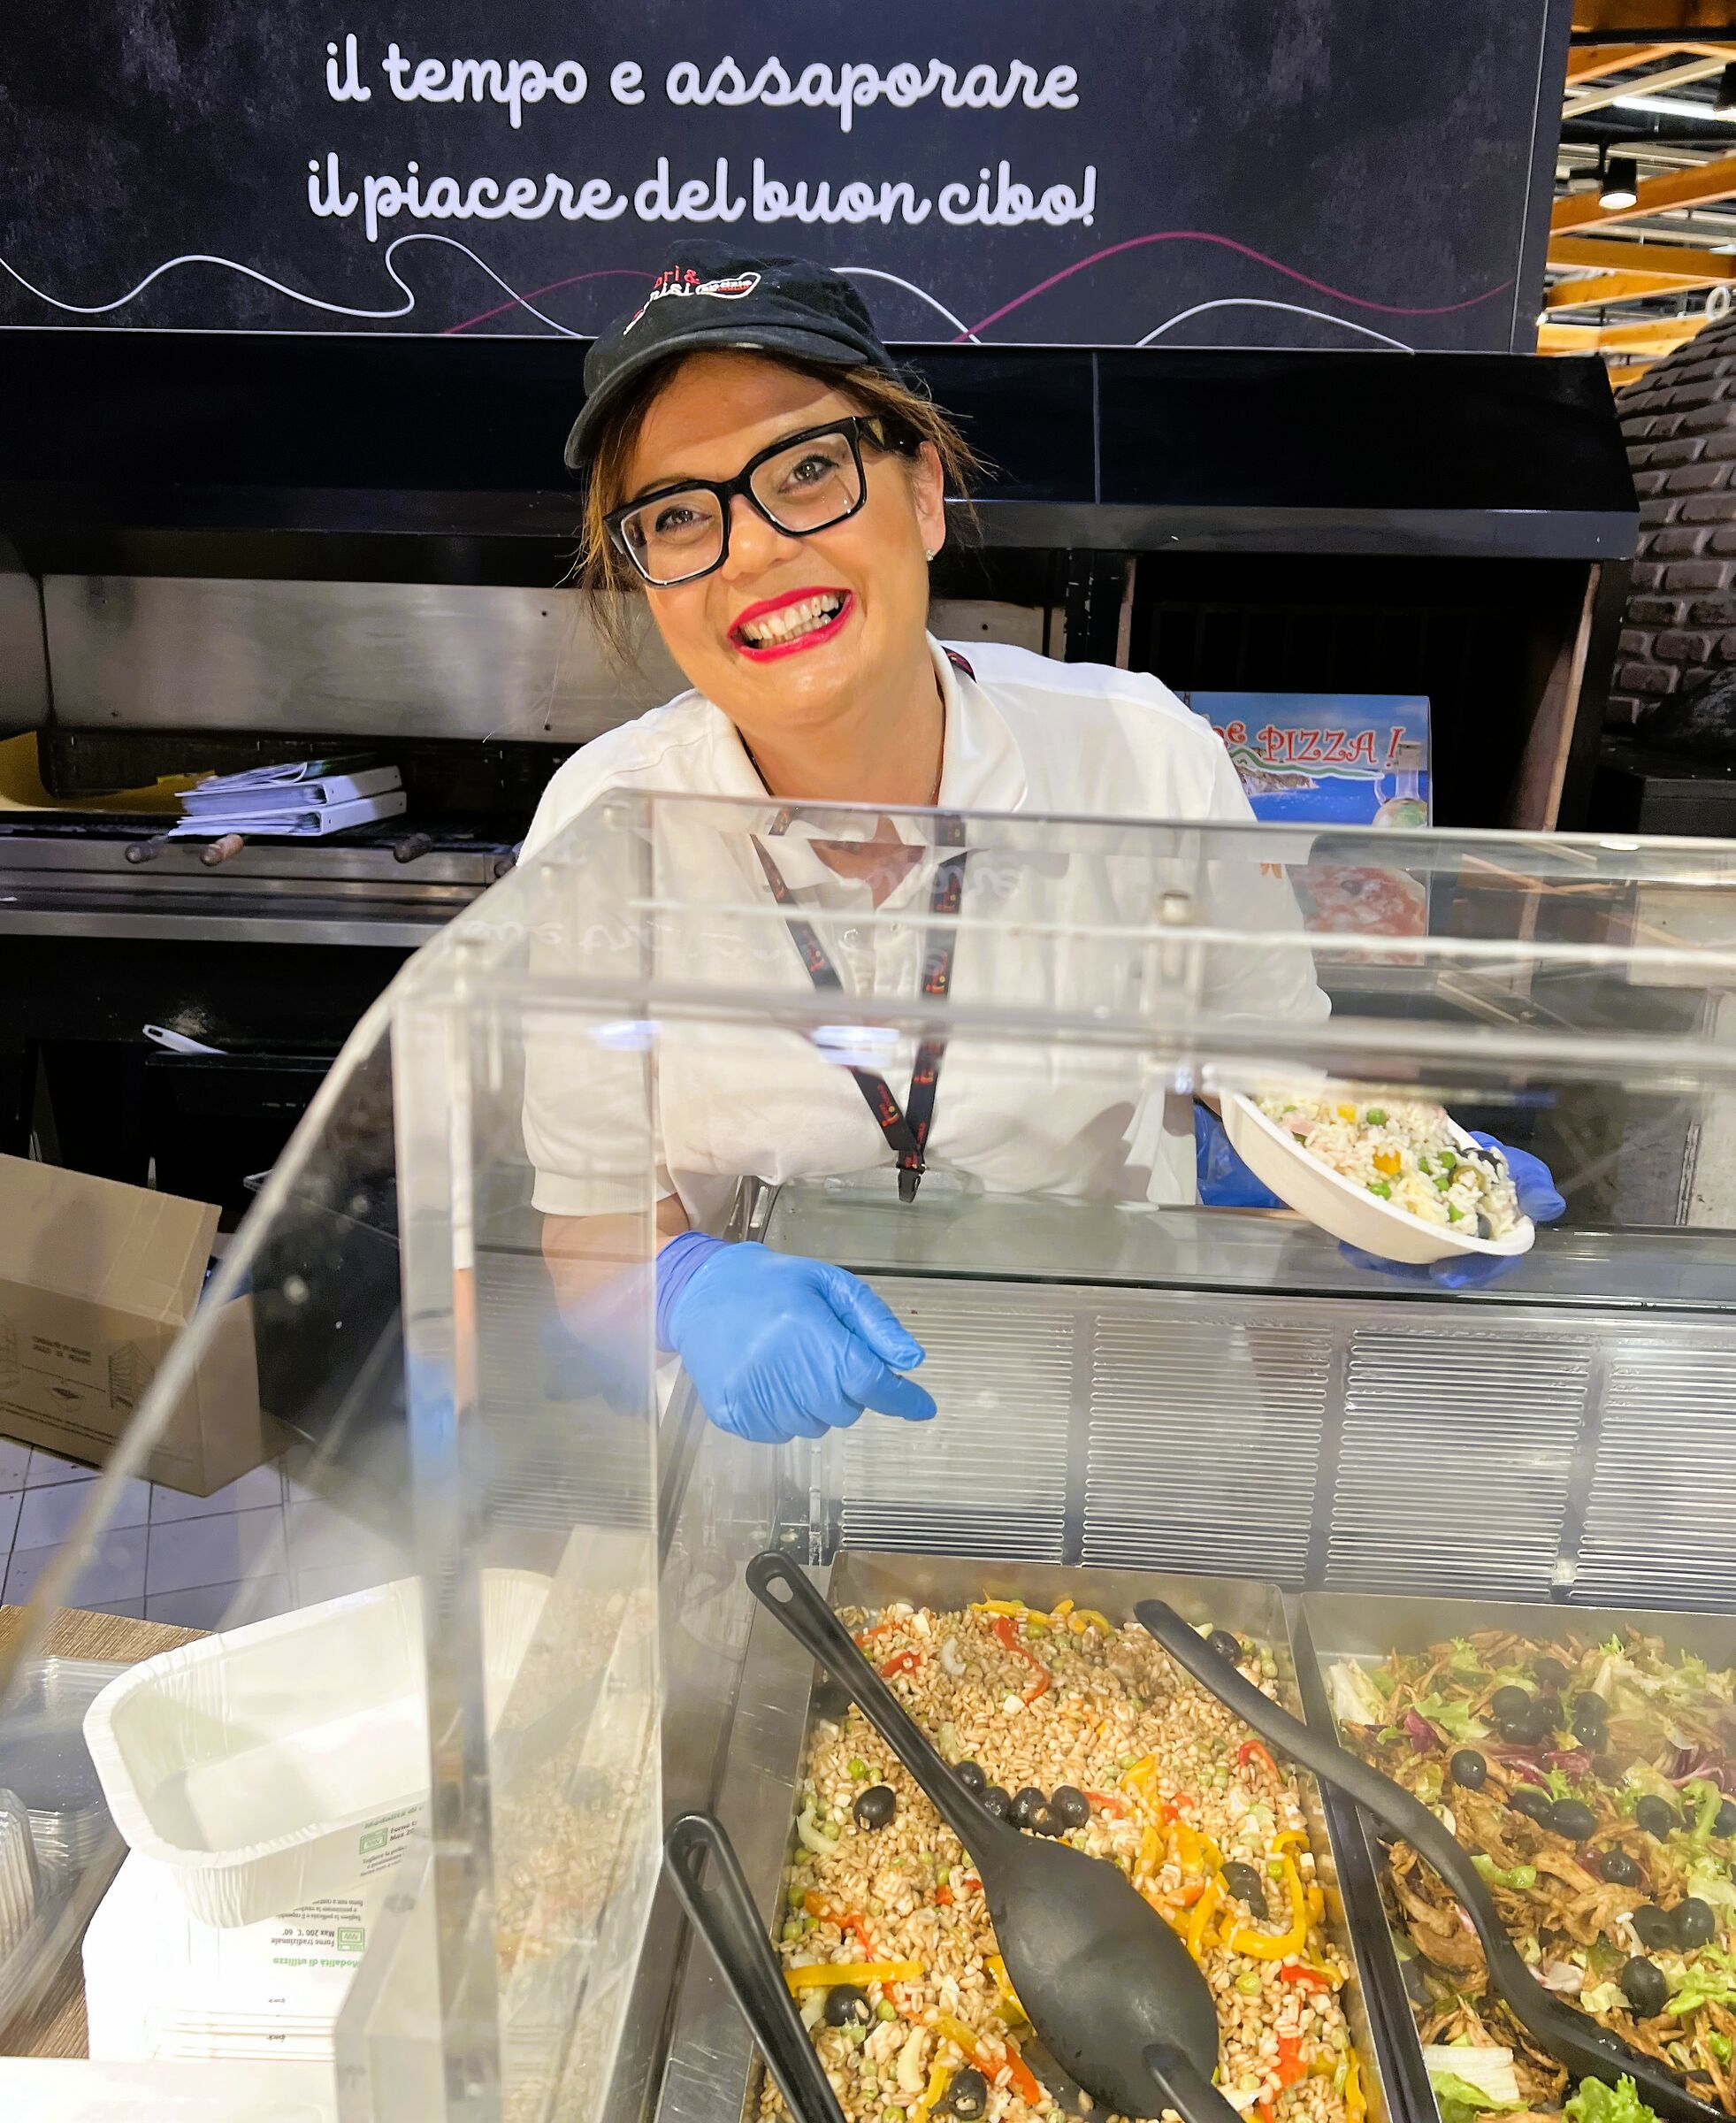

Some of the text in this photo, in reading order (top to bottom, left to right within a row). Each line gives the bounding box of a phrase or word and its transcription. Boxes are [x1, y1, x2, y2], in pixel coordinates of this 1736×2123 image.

[326, 33, 1081, 133] il tempo e assaporare
[308, 151, 1097, 242] il piacere del buon cibo!
[271, 1937, 313, 1946] tradizionale
[272, 1957, 307, 1967] utilizzo
